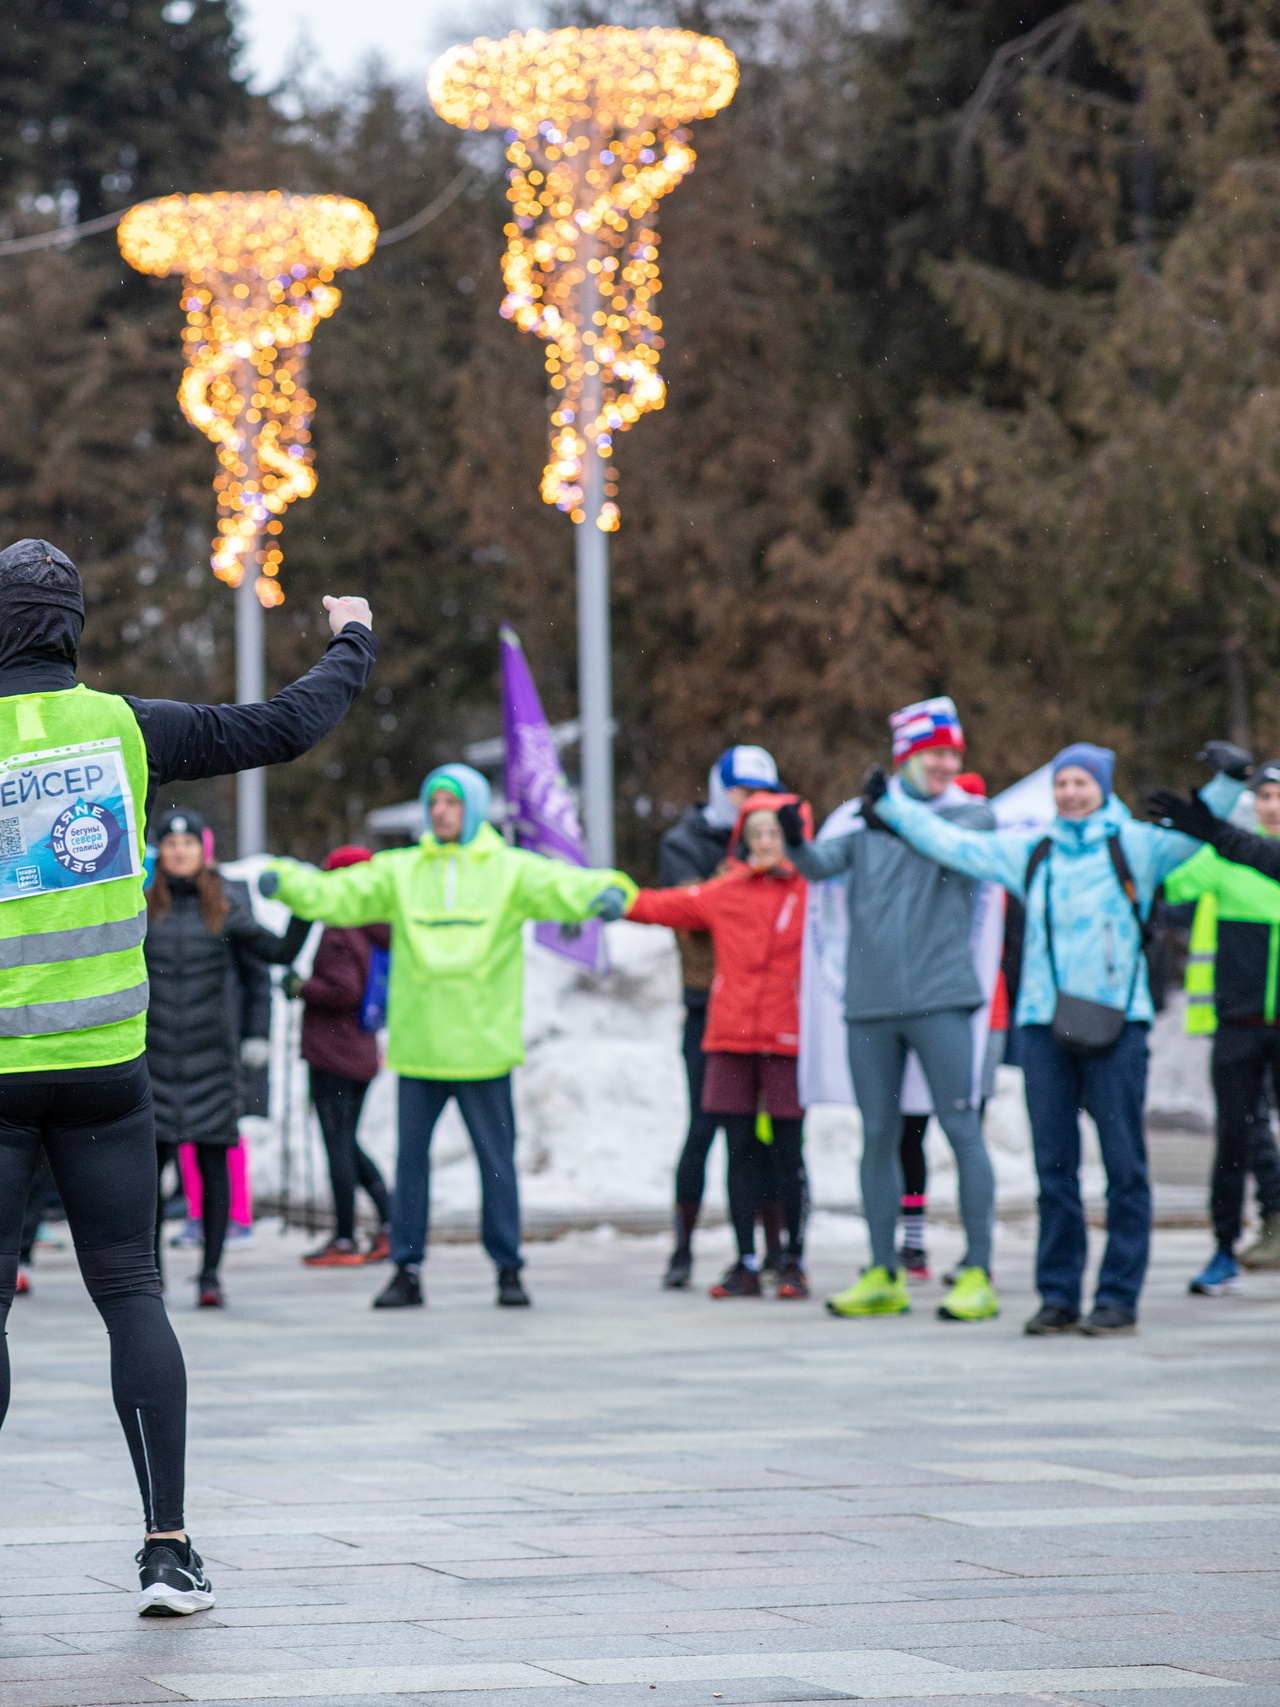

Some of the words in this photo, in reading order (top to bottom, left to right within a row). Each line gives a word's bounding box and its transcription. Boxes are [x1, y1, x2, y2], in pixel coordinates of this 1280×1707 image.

[71, 826, 99, 836] бегуны
[71, 833, 102, 845] севера
[72, 842, 103, 853] столицы
